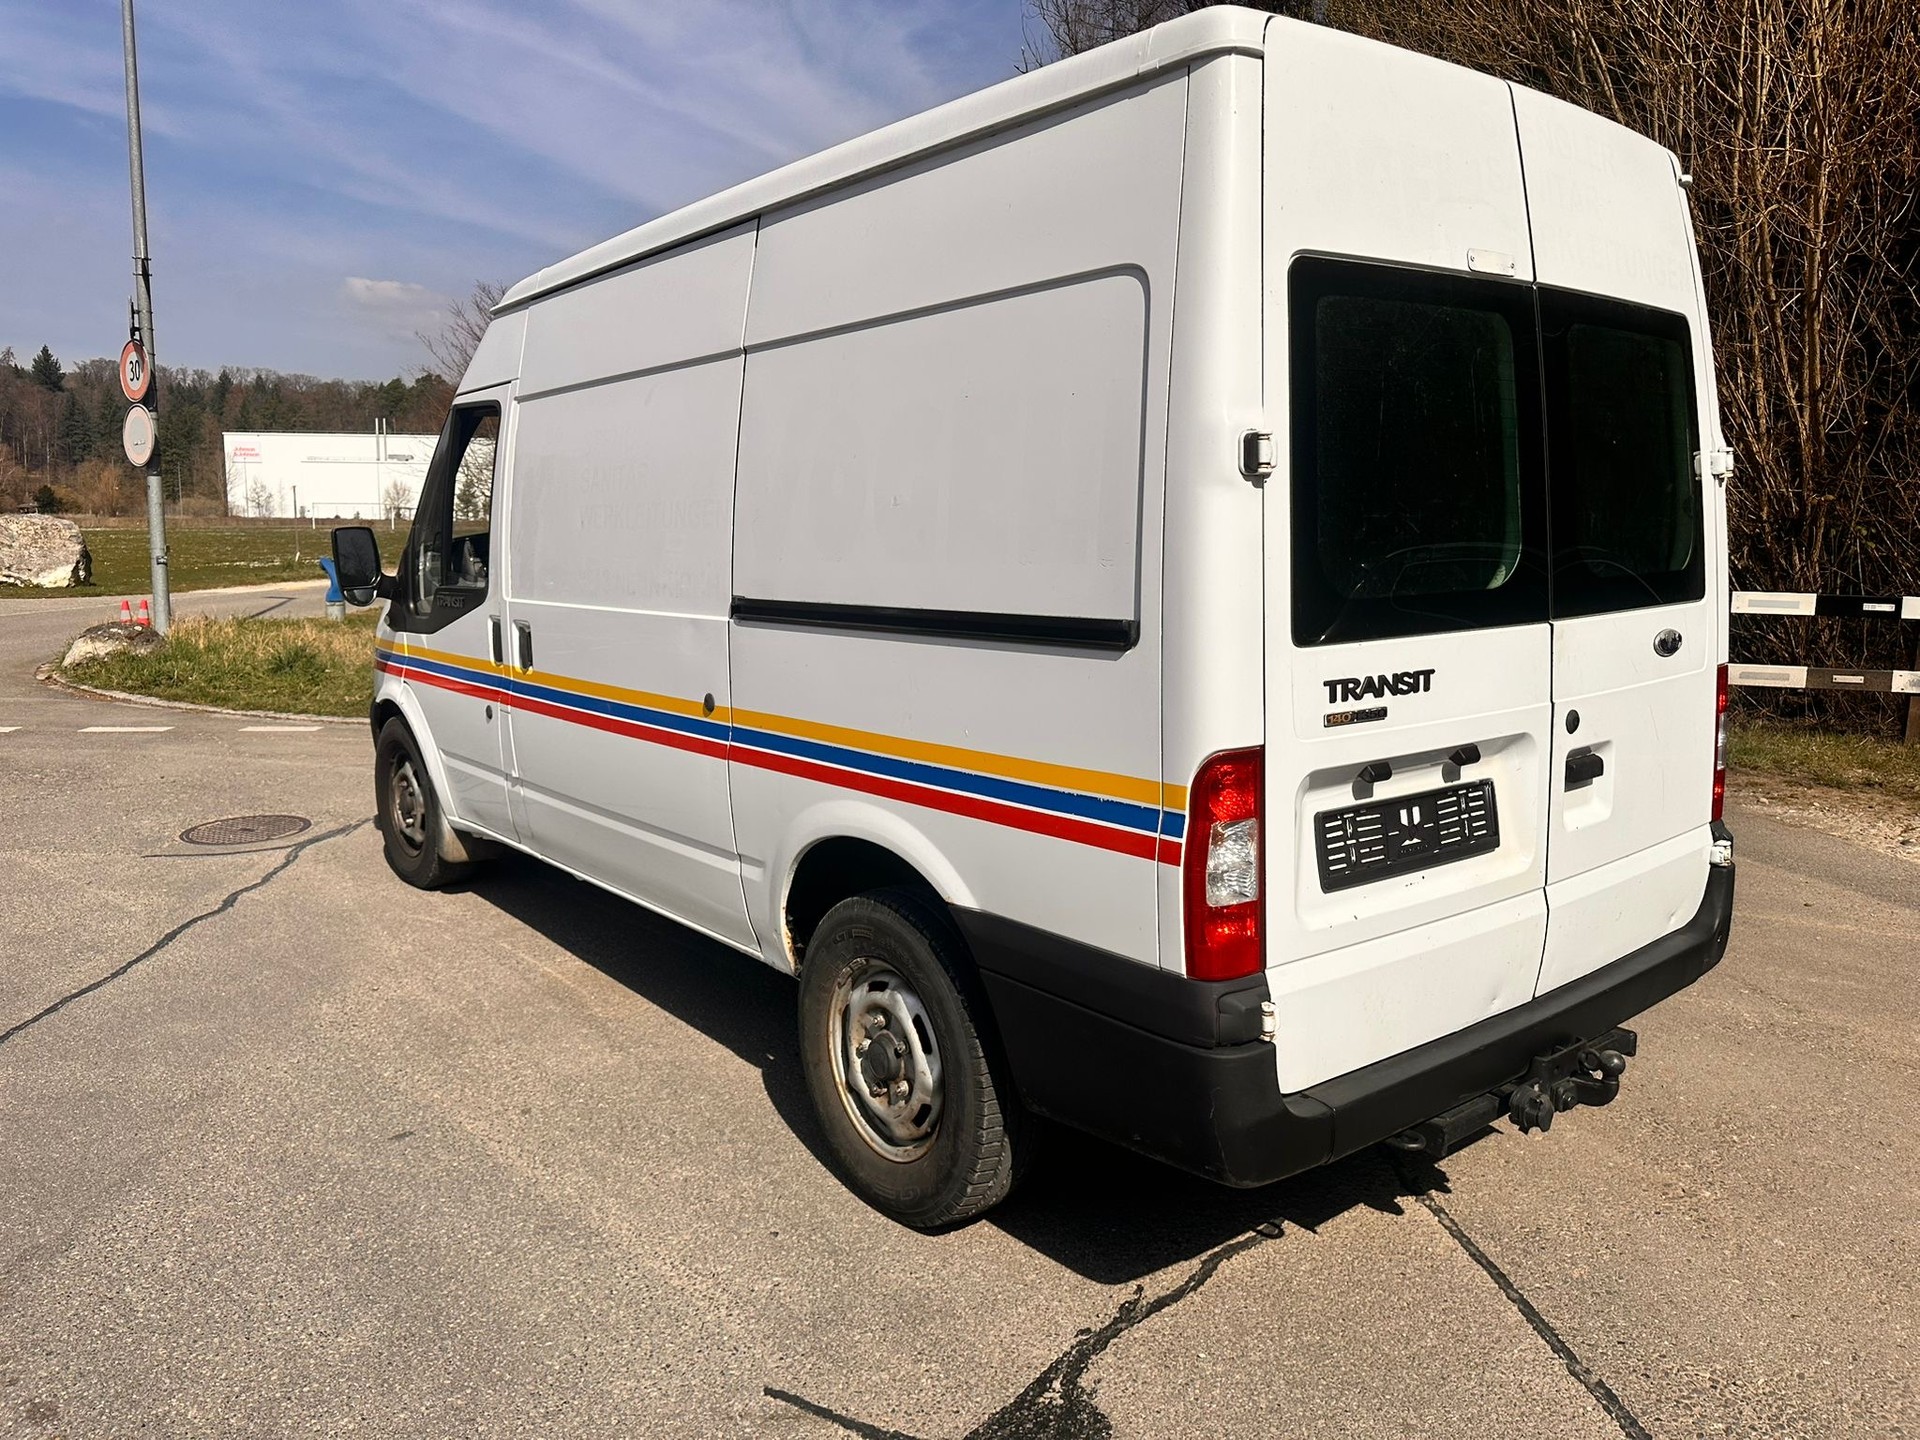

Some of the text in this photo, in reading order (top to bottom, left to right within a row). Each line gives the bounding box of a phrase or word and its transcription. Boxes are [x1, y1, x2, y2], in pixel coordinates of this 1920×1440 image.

[129, 360, 140, 382] 30
[1323, 668, 1436, 704] TRANSIT
[1328, 712, 1351, 724] 140
